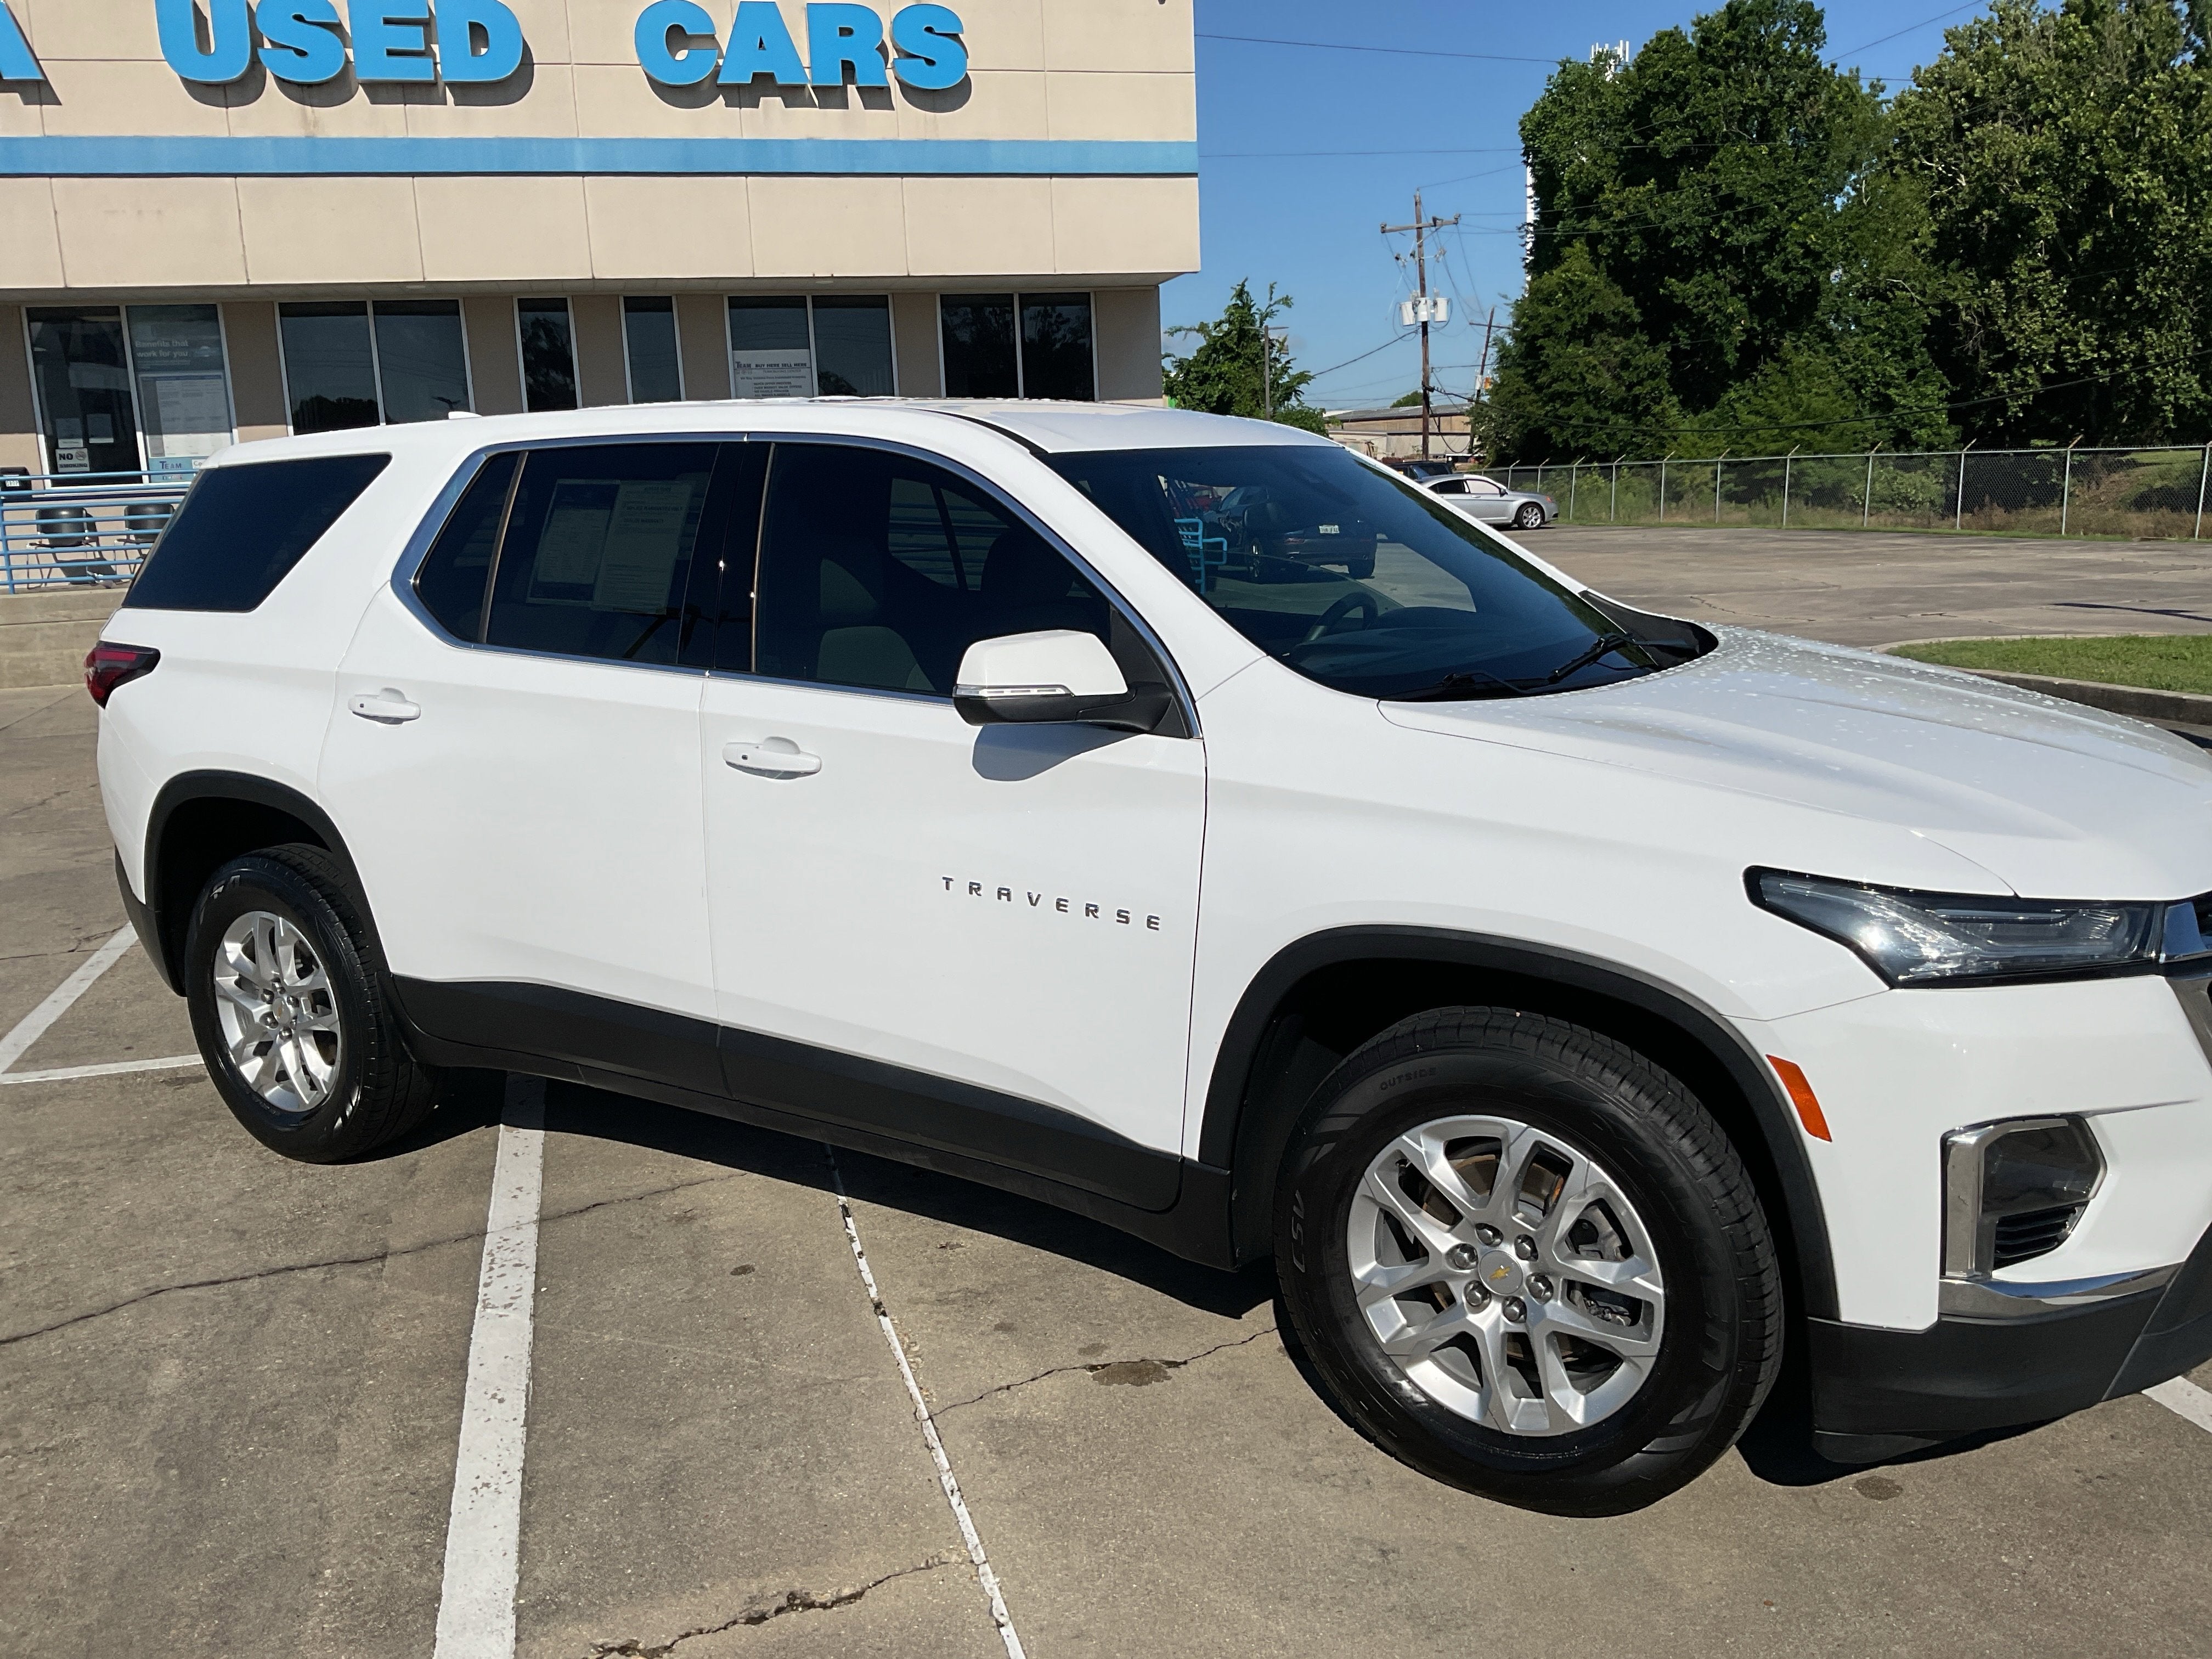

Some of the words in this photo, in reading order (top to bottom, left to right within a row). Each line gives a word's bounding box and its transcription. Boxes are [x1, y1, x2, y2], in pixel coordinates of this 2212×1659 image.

[155, 0, 523, 83] USED
[635, 0, 967, 89] CARS
[941, 876, 1161, 931] TRAVERSE
[1380, 1067, 1436, 1091] OUTSIDE
